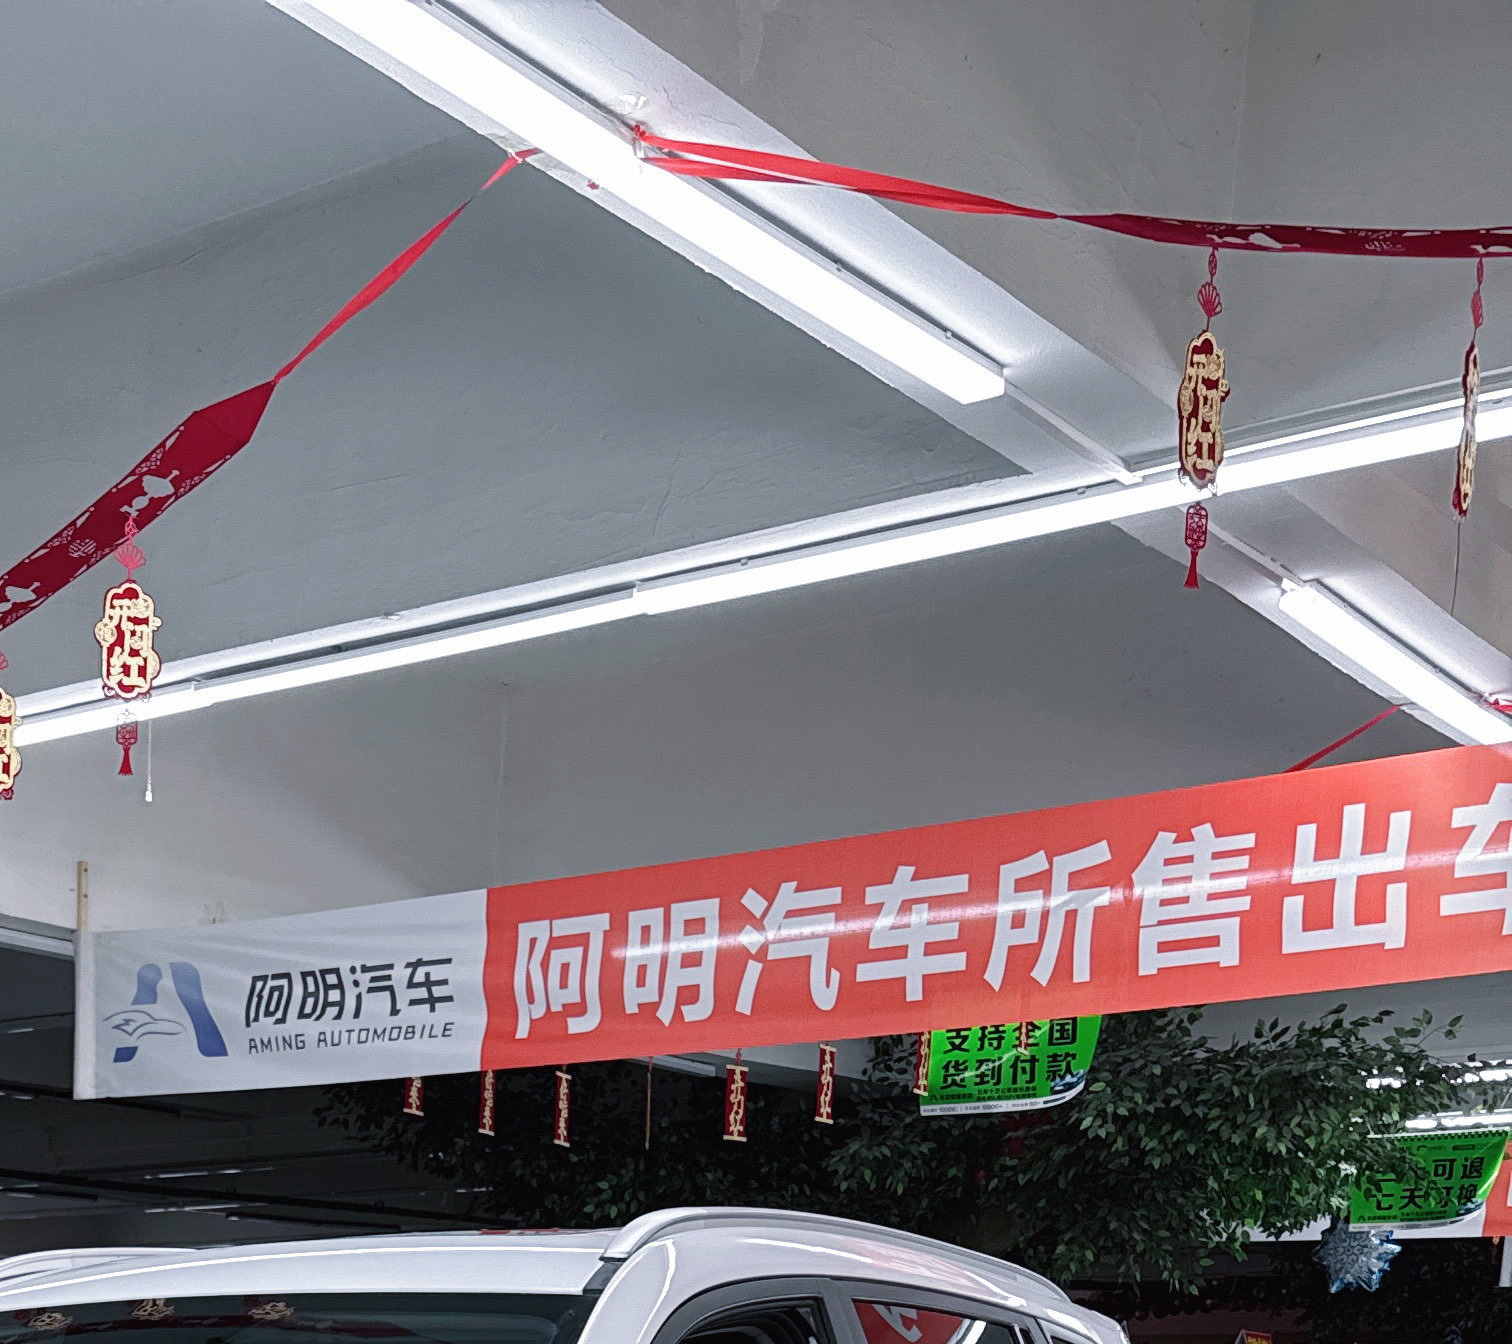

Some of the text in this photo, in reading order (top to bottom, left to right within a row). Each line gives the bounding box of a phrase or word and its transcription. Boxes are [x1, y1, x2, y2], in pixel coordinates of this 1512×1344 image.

[245, 957, 454, 1028] 阿明汽车
[248, 1022, 454, 1055] AMING AUTOMOBILE
[940, 1052, 1077, 1090] 货到付款
